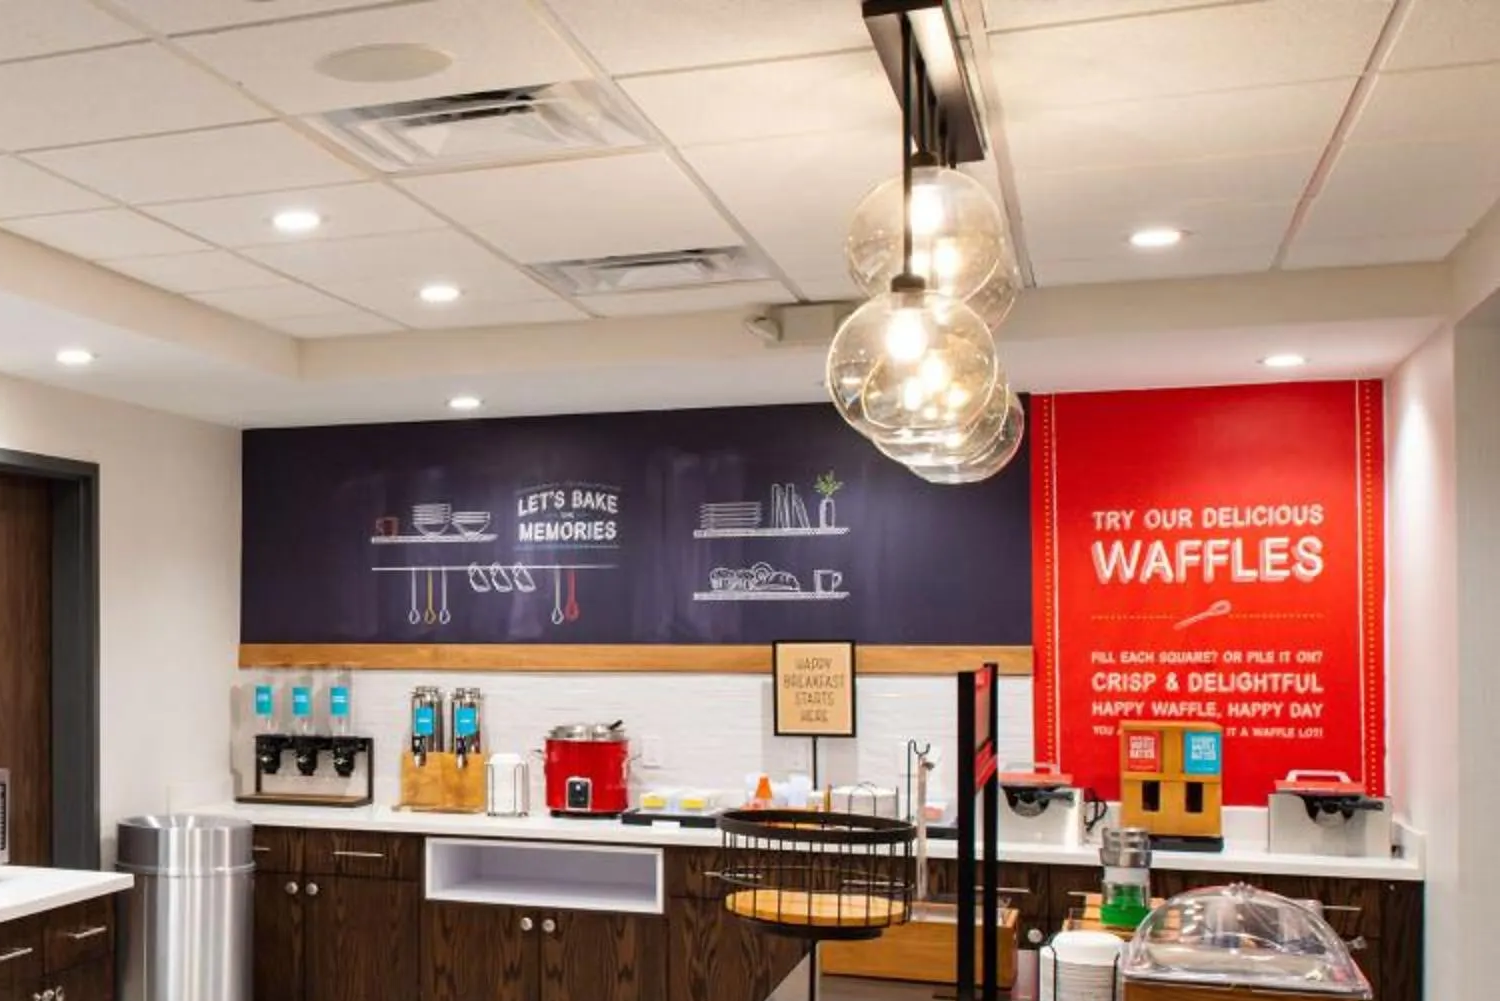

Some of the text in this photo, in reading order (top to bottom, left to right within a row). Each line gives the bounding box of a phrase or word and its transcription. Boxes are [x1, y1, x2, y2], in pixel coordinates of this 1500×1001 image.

[517, 489, 619, 517] LET'S BAKE
[1092, 503, 1324, 532] TRY OUR DELICIOUS
[518, 520, 618, 542] MEMORIES
[1091, 536, 1325, 585] WAFFLES
[795, 657, 833, 671] HAPPY
[1092, 651, 1324, 665] FILL EACH SQUARE? OR PILE IT ON?
[783, 673, 844, 689] BREAKFAST
[1091, 671, 1325, 694] CRISP & DELIGHTFUL
[795, 691, 835, 706] STARTS
[800, 709, 829, 722] HERE
[1092, 701, 1325, 719] HAPPY WAFFLE, HAPPY DAY
[1092, 725, 1115, 736] YOU
[1226, 726, 1236, 737] IT
[1240, 726, 1249, 737] A
[1252, 727, 1296, 738] WAFFLE
